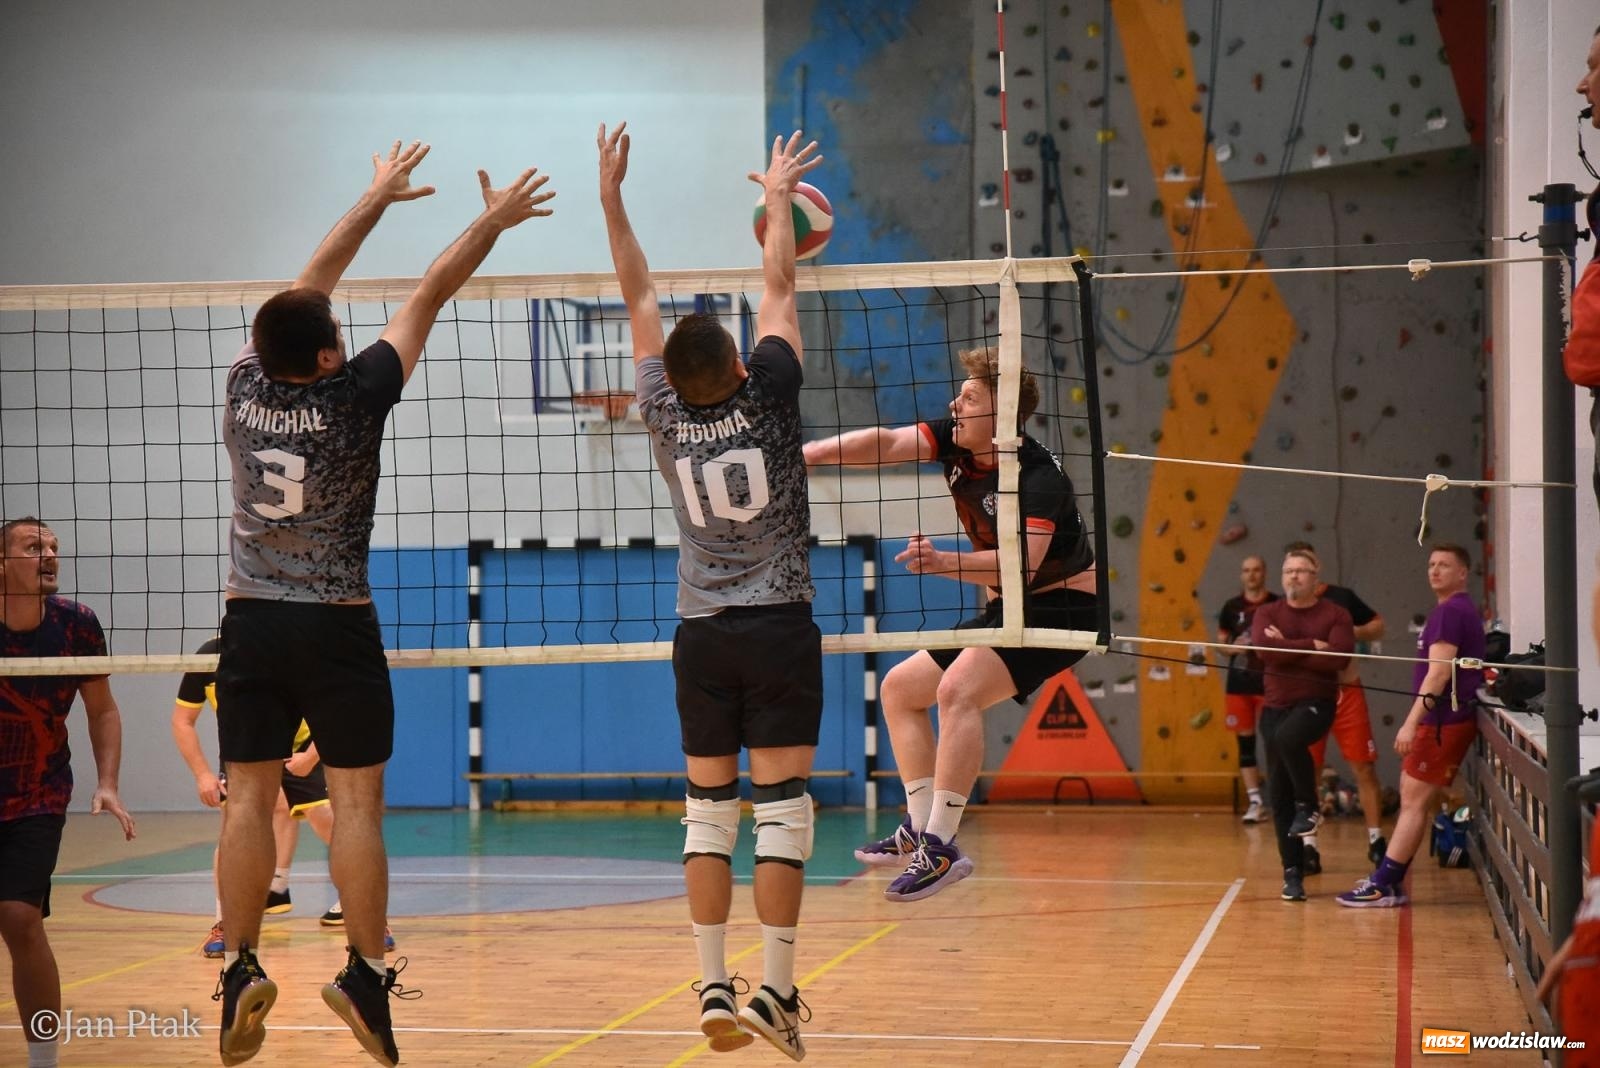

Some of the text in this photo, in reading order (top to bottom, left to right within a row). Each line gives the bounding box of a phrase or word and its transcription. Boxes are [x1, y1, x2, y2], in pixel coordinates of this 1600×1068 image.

[235, 398, 328, 434] #MICHAŁ
[675, 409, 751, 444] #GUMA
[250, 448, 305, 520] 3
[675, 448, 770, 528] 10
